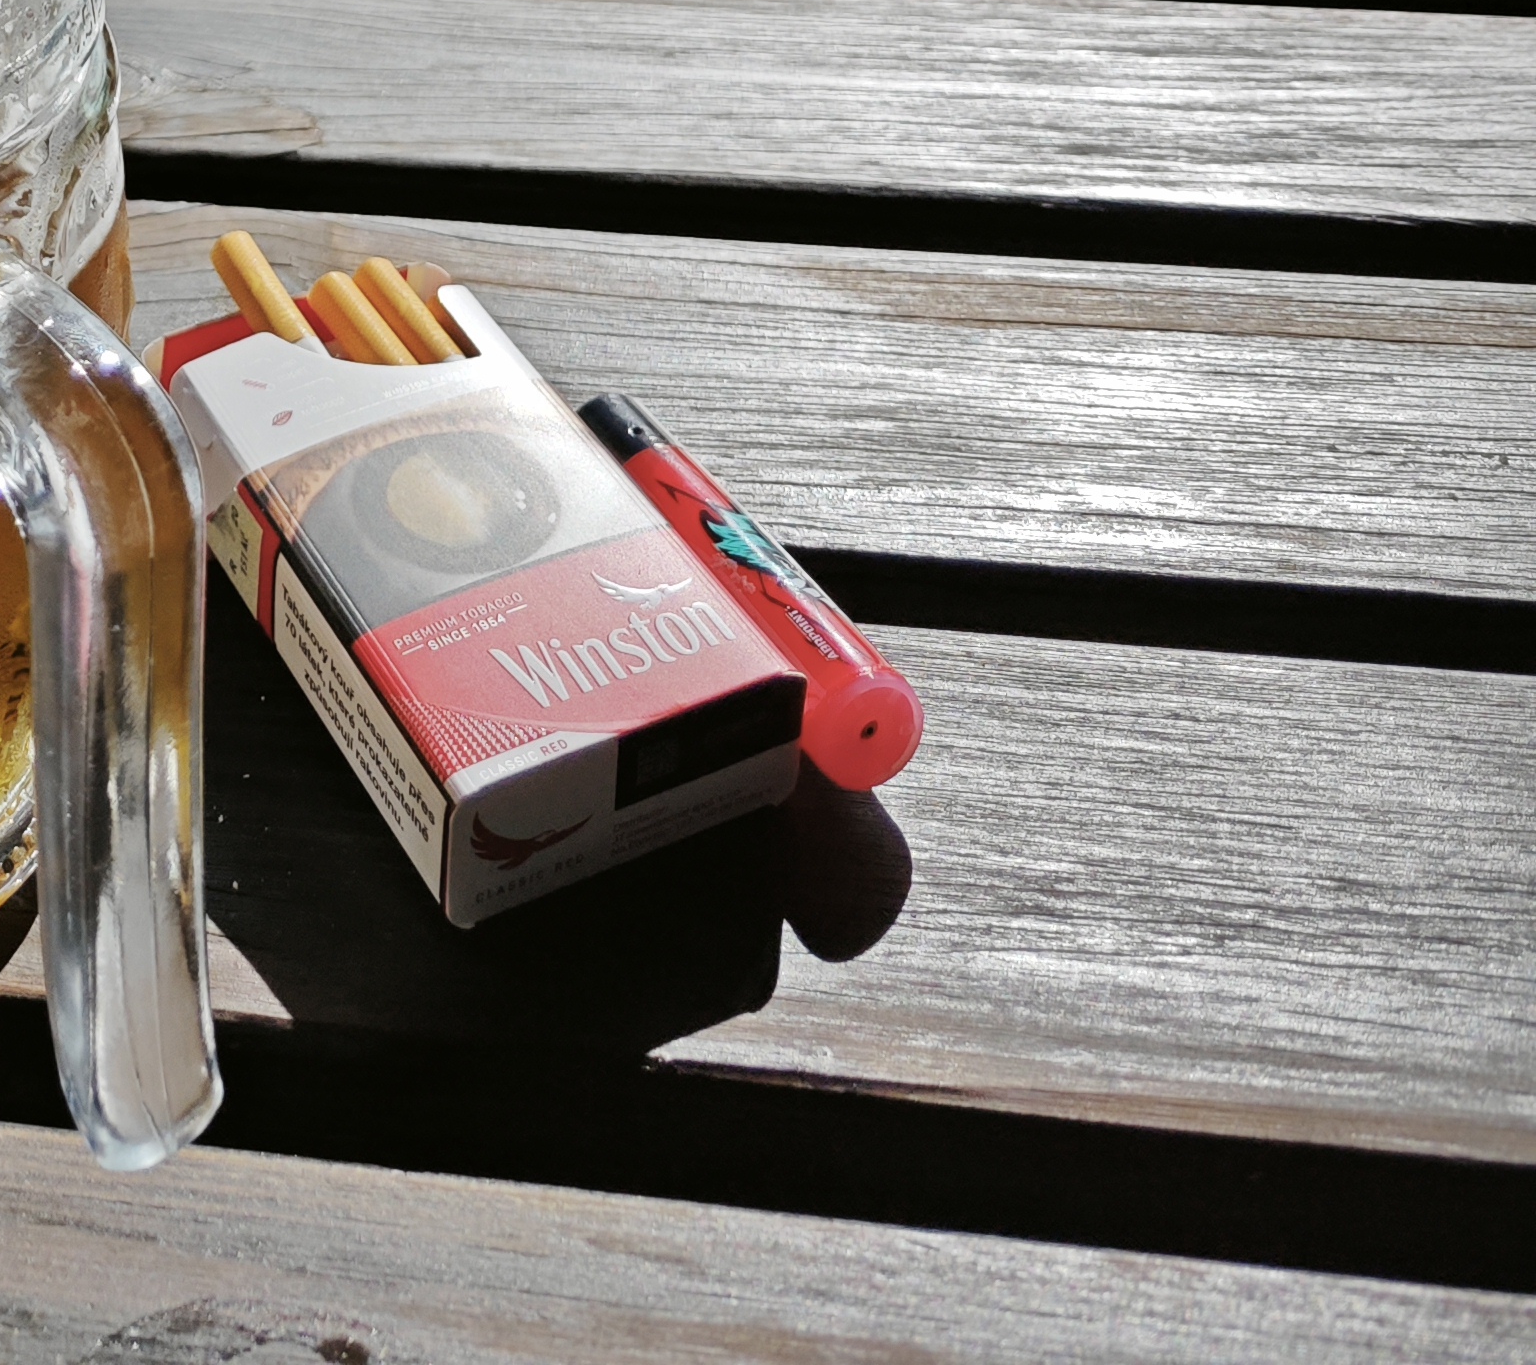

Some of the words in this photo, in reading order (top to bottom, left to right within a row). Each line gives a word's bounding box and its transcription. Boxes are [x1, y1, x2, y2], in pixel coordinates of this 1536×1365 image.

[393, 614, 459, 650] PREMIUM
[459, 591, 524, 622] TOBACCO
[427, 626, 472, 651] SINCE
[472, 613, 507, 637] 1954
[488, 601, 737, 709] Winston
[282, 583, 328, 663] Tabákový
[330, 658, 355, 701] kouř
[356, 703, 406, 782] obsahuje
[408, 781, 435, 825] přes
[285, 613, 296, 639] 70
[329, 681, 355, 729] které
[358, 729, 429, 842] prokazatelně
[304, 668, 353, 751] způsobují
[356, 748, 405, 831] rakovinu.
[479, 750, 539, 782] CLASSIC
[539, 739, 569, 757] RED
[476, 869, 544, 904] CLASSIC
[554, 853, 585, 873] RED
